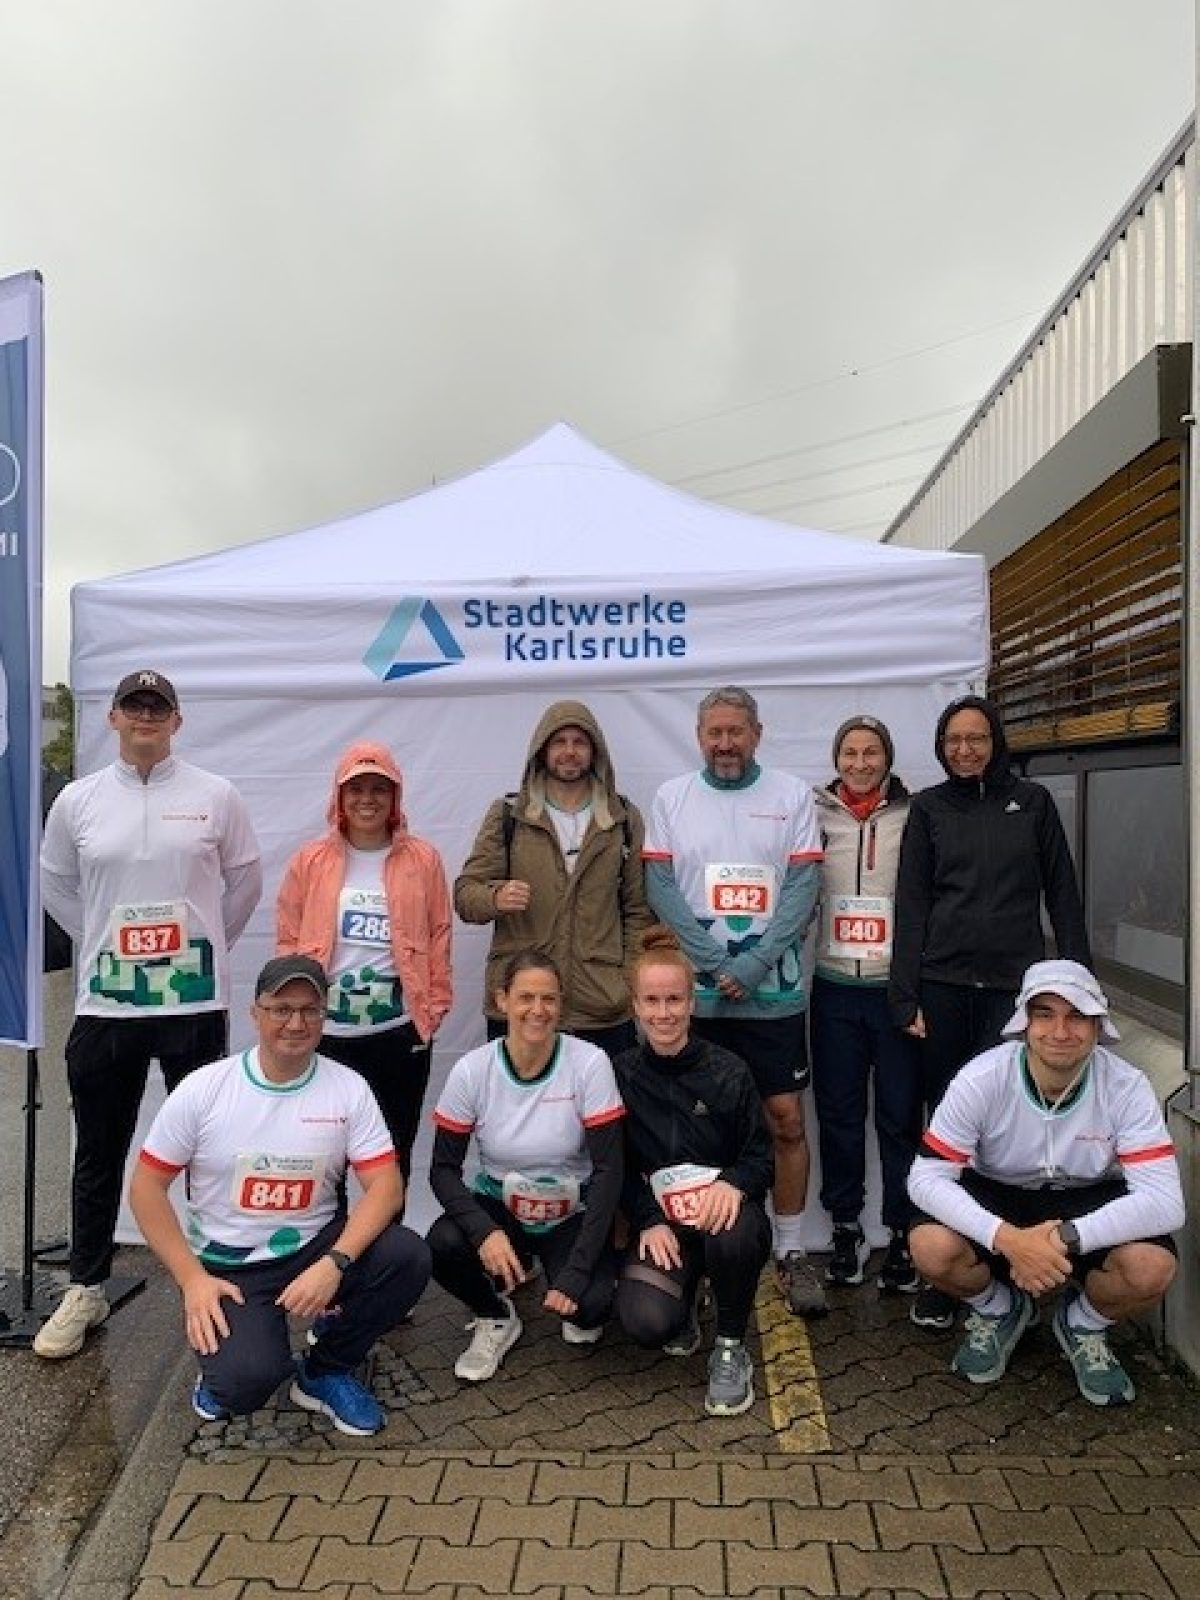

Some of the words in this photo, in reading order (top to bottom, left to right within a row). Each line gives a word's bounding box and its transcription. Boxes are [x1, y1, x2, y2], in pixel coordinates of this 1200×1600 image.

[463, 594, 686, 628] Stadtwerke
[505, 627, 686, 661] Karlsruhe
[719, 887, 762, 909] 842
[127, 927, 172, 952] 837
[839, 919, 879, 941] 840
[249, 1182, 303, 1209] 841
[669, 1189, 704, 1219] 83
